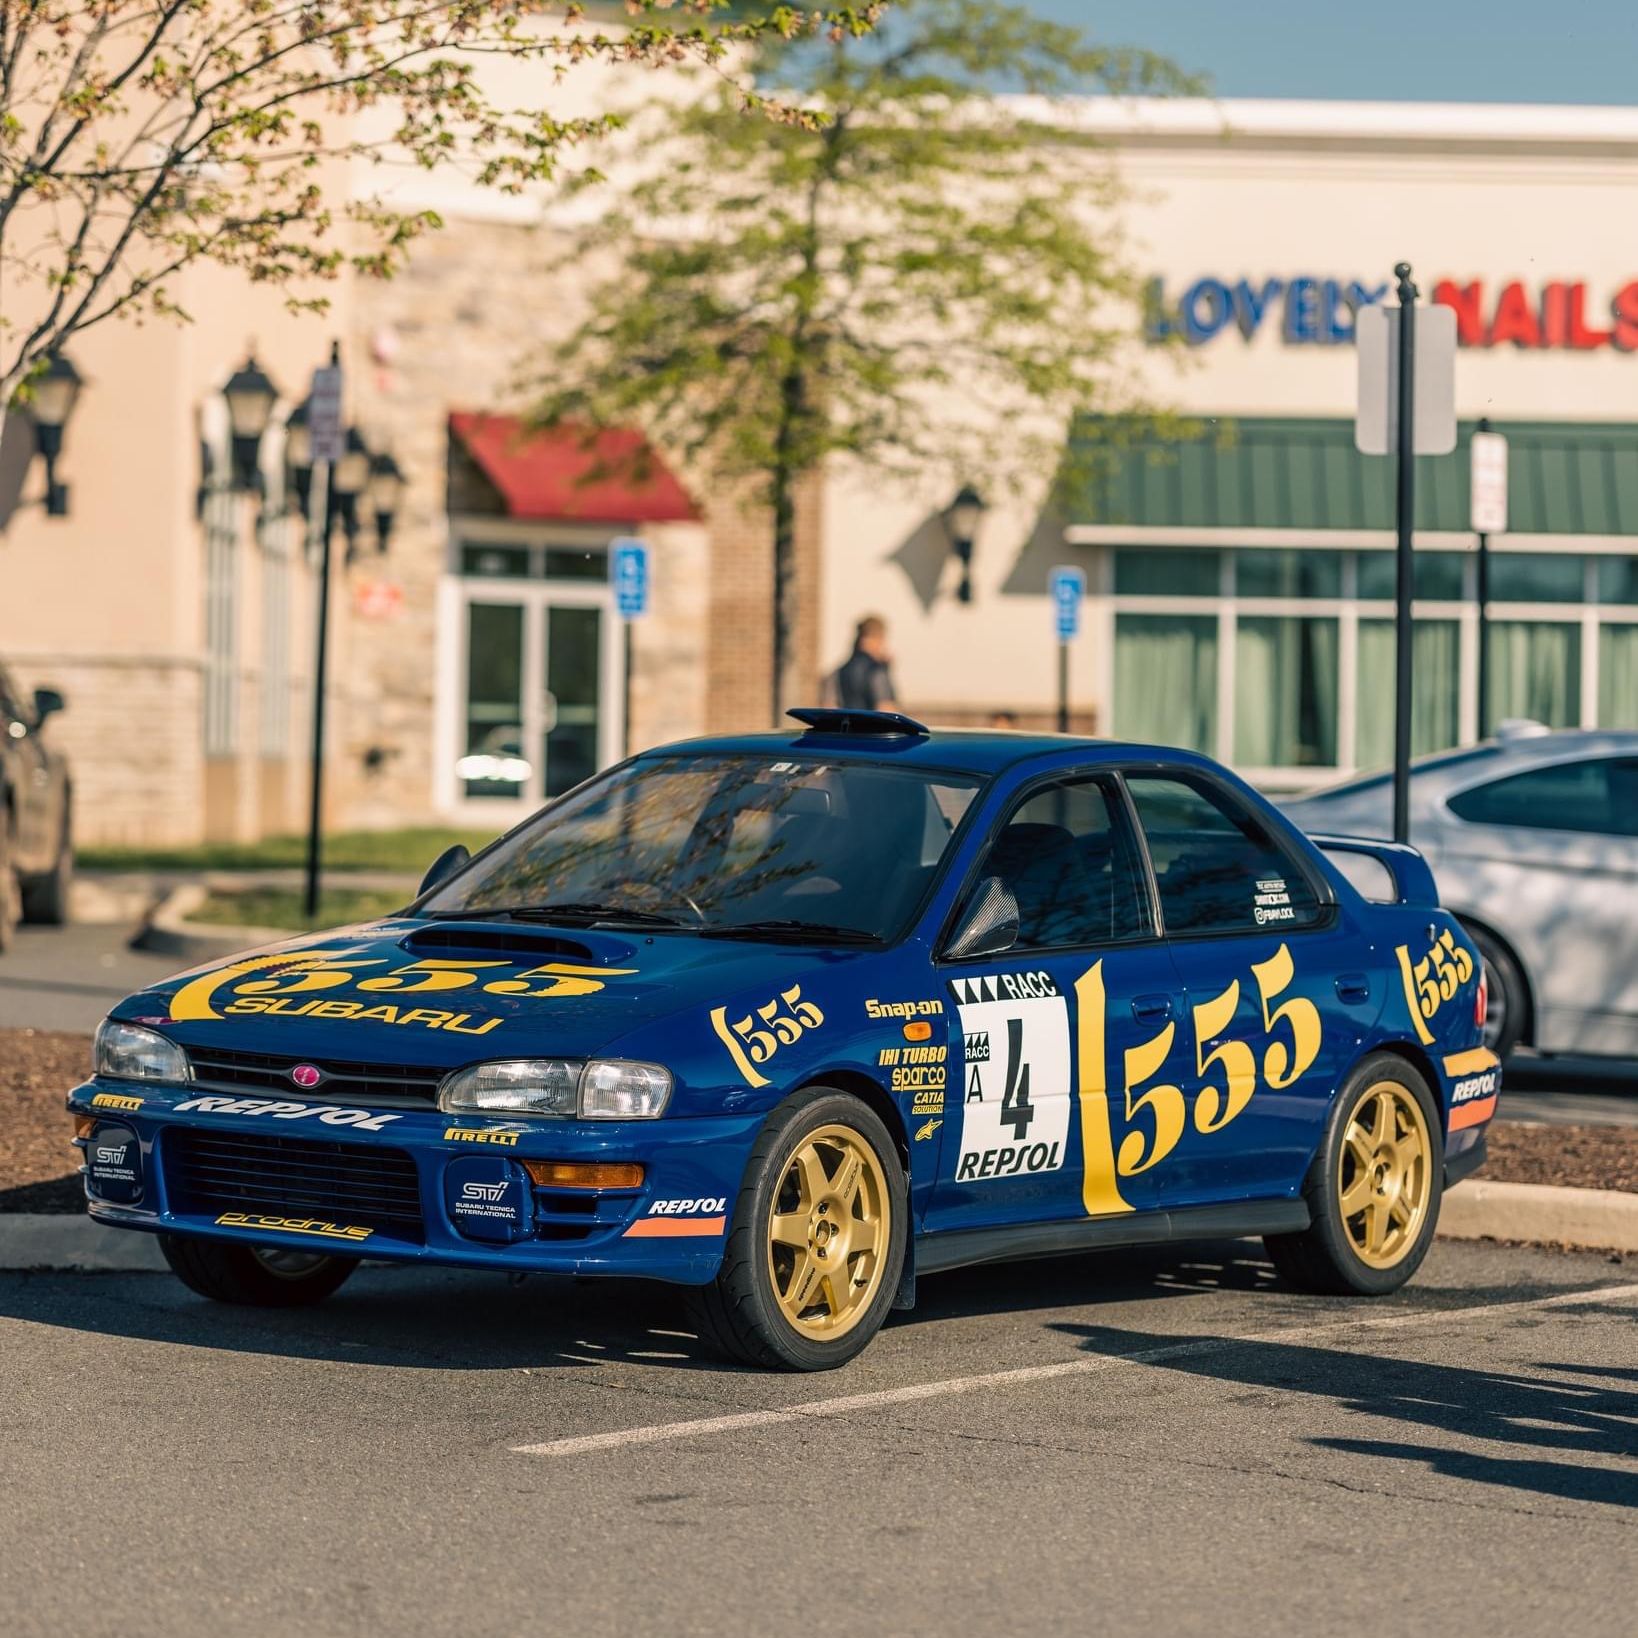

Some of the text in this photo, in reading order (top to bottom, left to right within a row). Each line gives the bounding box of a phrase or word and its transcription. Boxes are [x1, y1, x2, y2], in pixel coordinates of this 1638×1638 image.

[1001, 971, 1057, 998] RACC
[223, 997, 505, 1035] SUBARU
[865, 999, 944, 1020] Snap-on
[878, 1046, 947, 1066] IHI TURBO
[965, 1045, 990, 1059] RACC
[891, 1066, 946, 1092] sparco
[966, 1064, 984, 1104] A
[1000, 1018, 1034, 1140] 4
[1451, 1073, 1496, 1103] REPSOL
[92, 1093, 145, 1111] PIRELLI
[914, 1092, 945, 1105] CATIA
[173, 1096, 404, 1131] REPSOL
[443, 1127, 521, 1146] PIRELLI
[957, 1142, 1059, 1179] REPSOL
[455, 1202, 516, 1213] SUBARU TECNICA
[455, 1208, 517, 1219] INTERNATIONAL
[648, 1198, 726, 1214] REPSOL
[214, 1212, 374, 1241] prodrive
